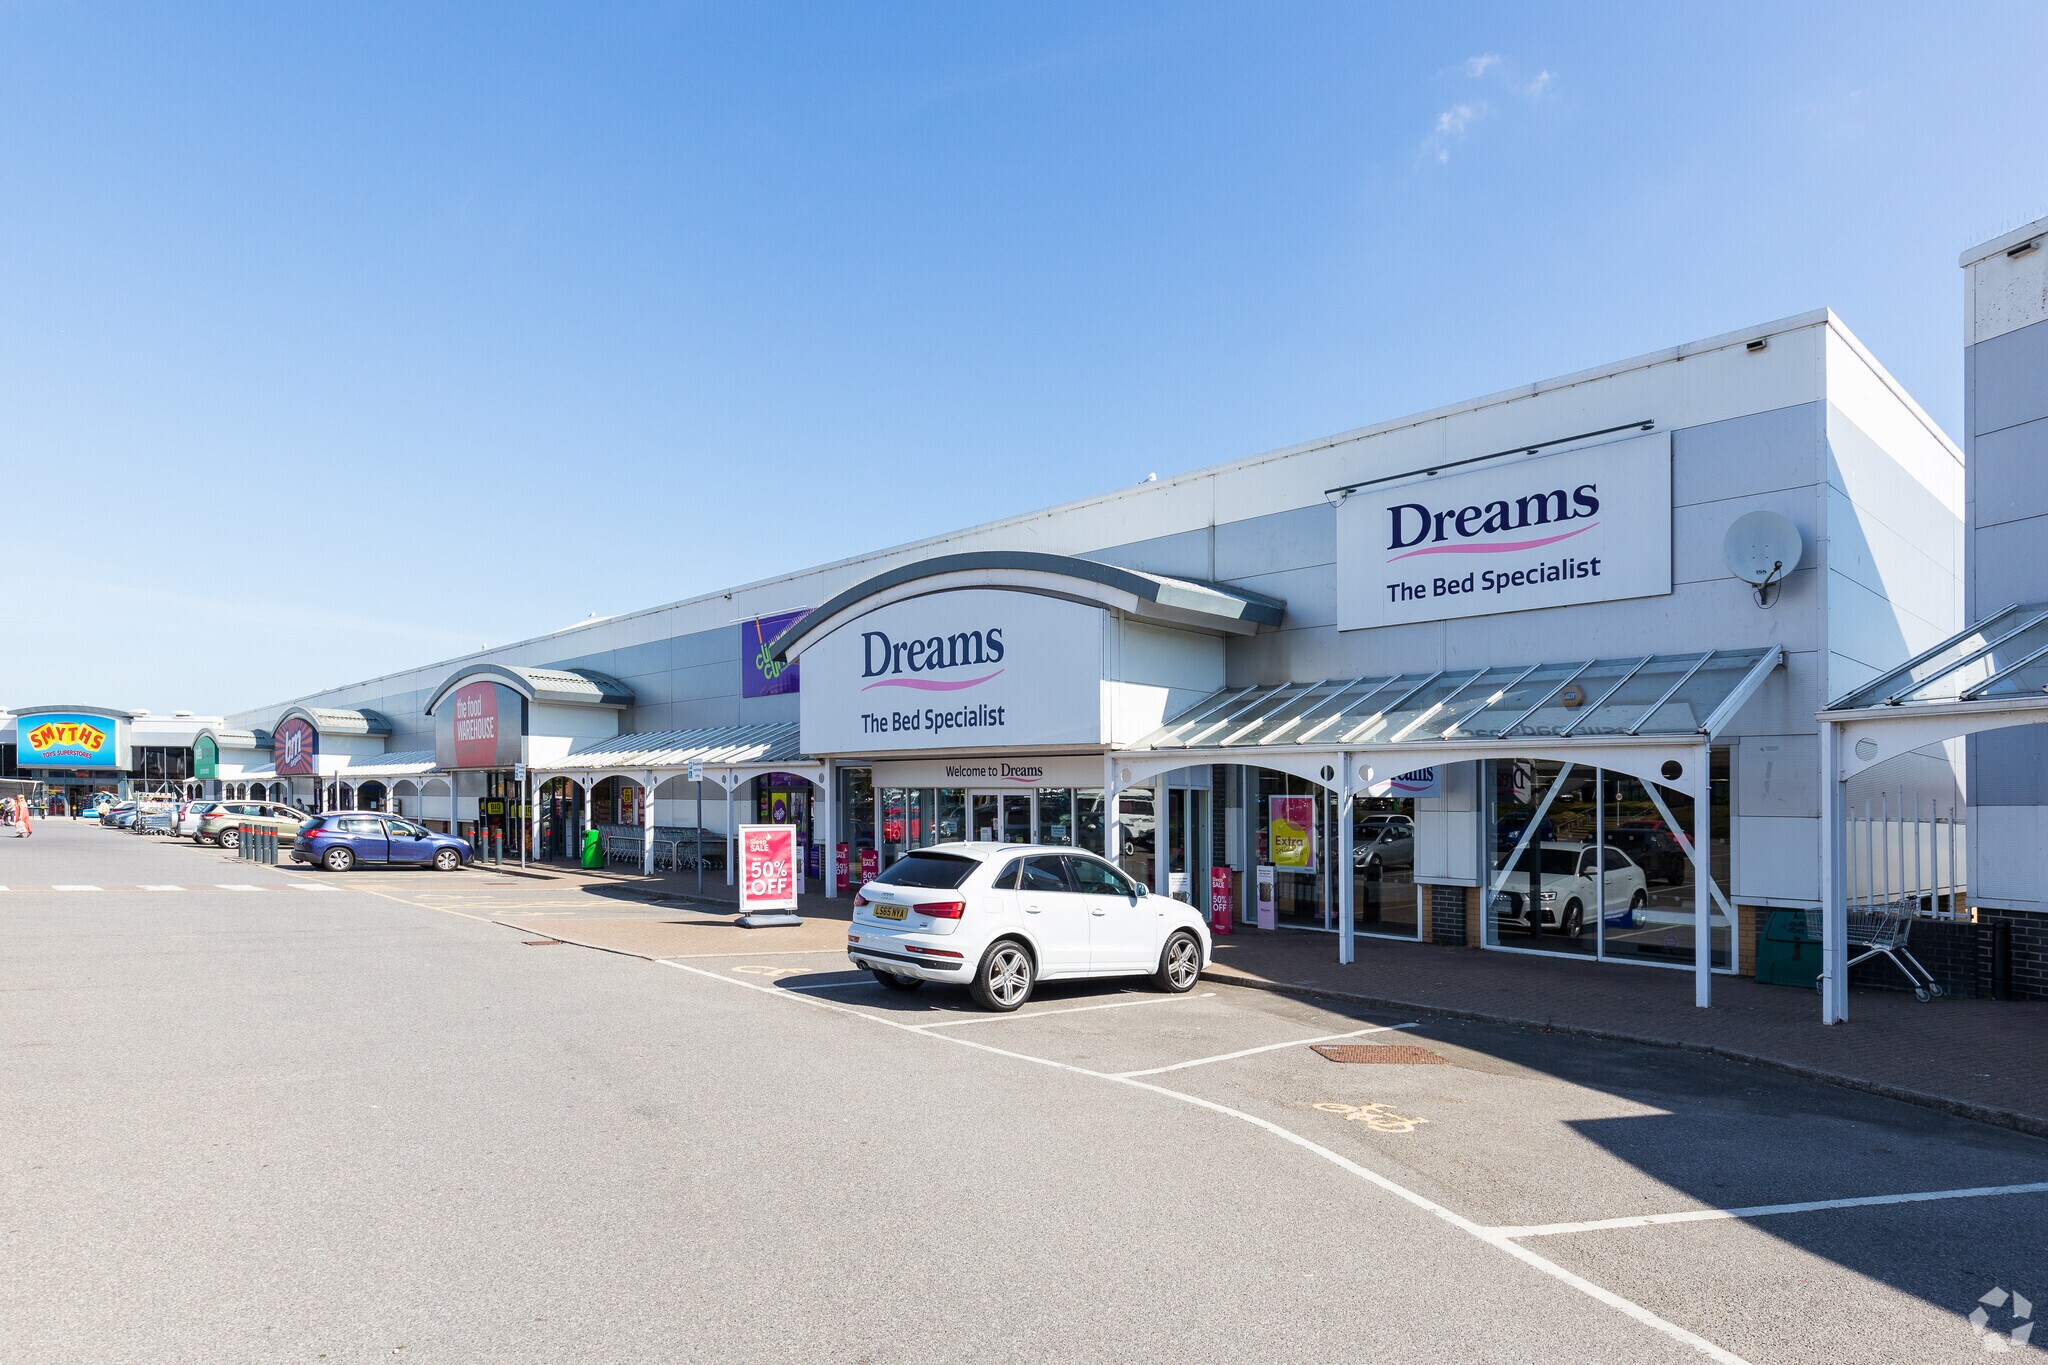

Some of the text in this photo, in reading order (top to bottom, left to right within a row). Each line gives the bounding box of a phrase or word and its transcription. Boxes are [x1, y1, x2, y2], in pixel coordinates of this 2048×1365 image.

[1387, 483, 1600, 550] Dreams
[1387, 557, 1601, 602] The Bed Specialist
[861, 628, 1005, 678] Dreams
[457, 693, 482, 718] the food
[861, 704, 1005, 734] The Bed Specialist
[30, 726, 103, 749] SMYTHS
[457, 717, 495, 741] WAREHOUSE
[945, 763, 1043, 777] Welcome to Dreams
[750, 838, 768, 846] Sleep
[1275, 836, 1303, 846] Extra
[751, 860, 788, 878] 50%
[750, 878, 788, 896] OFF
[1213, 895, 1227, 904] 50%
[1213, 904, 1227, 912] OFF
[875, 904, 905, 918] LS65 NYA
